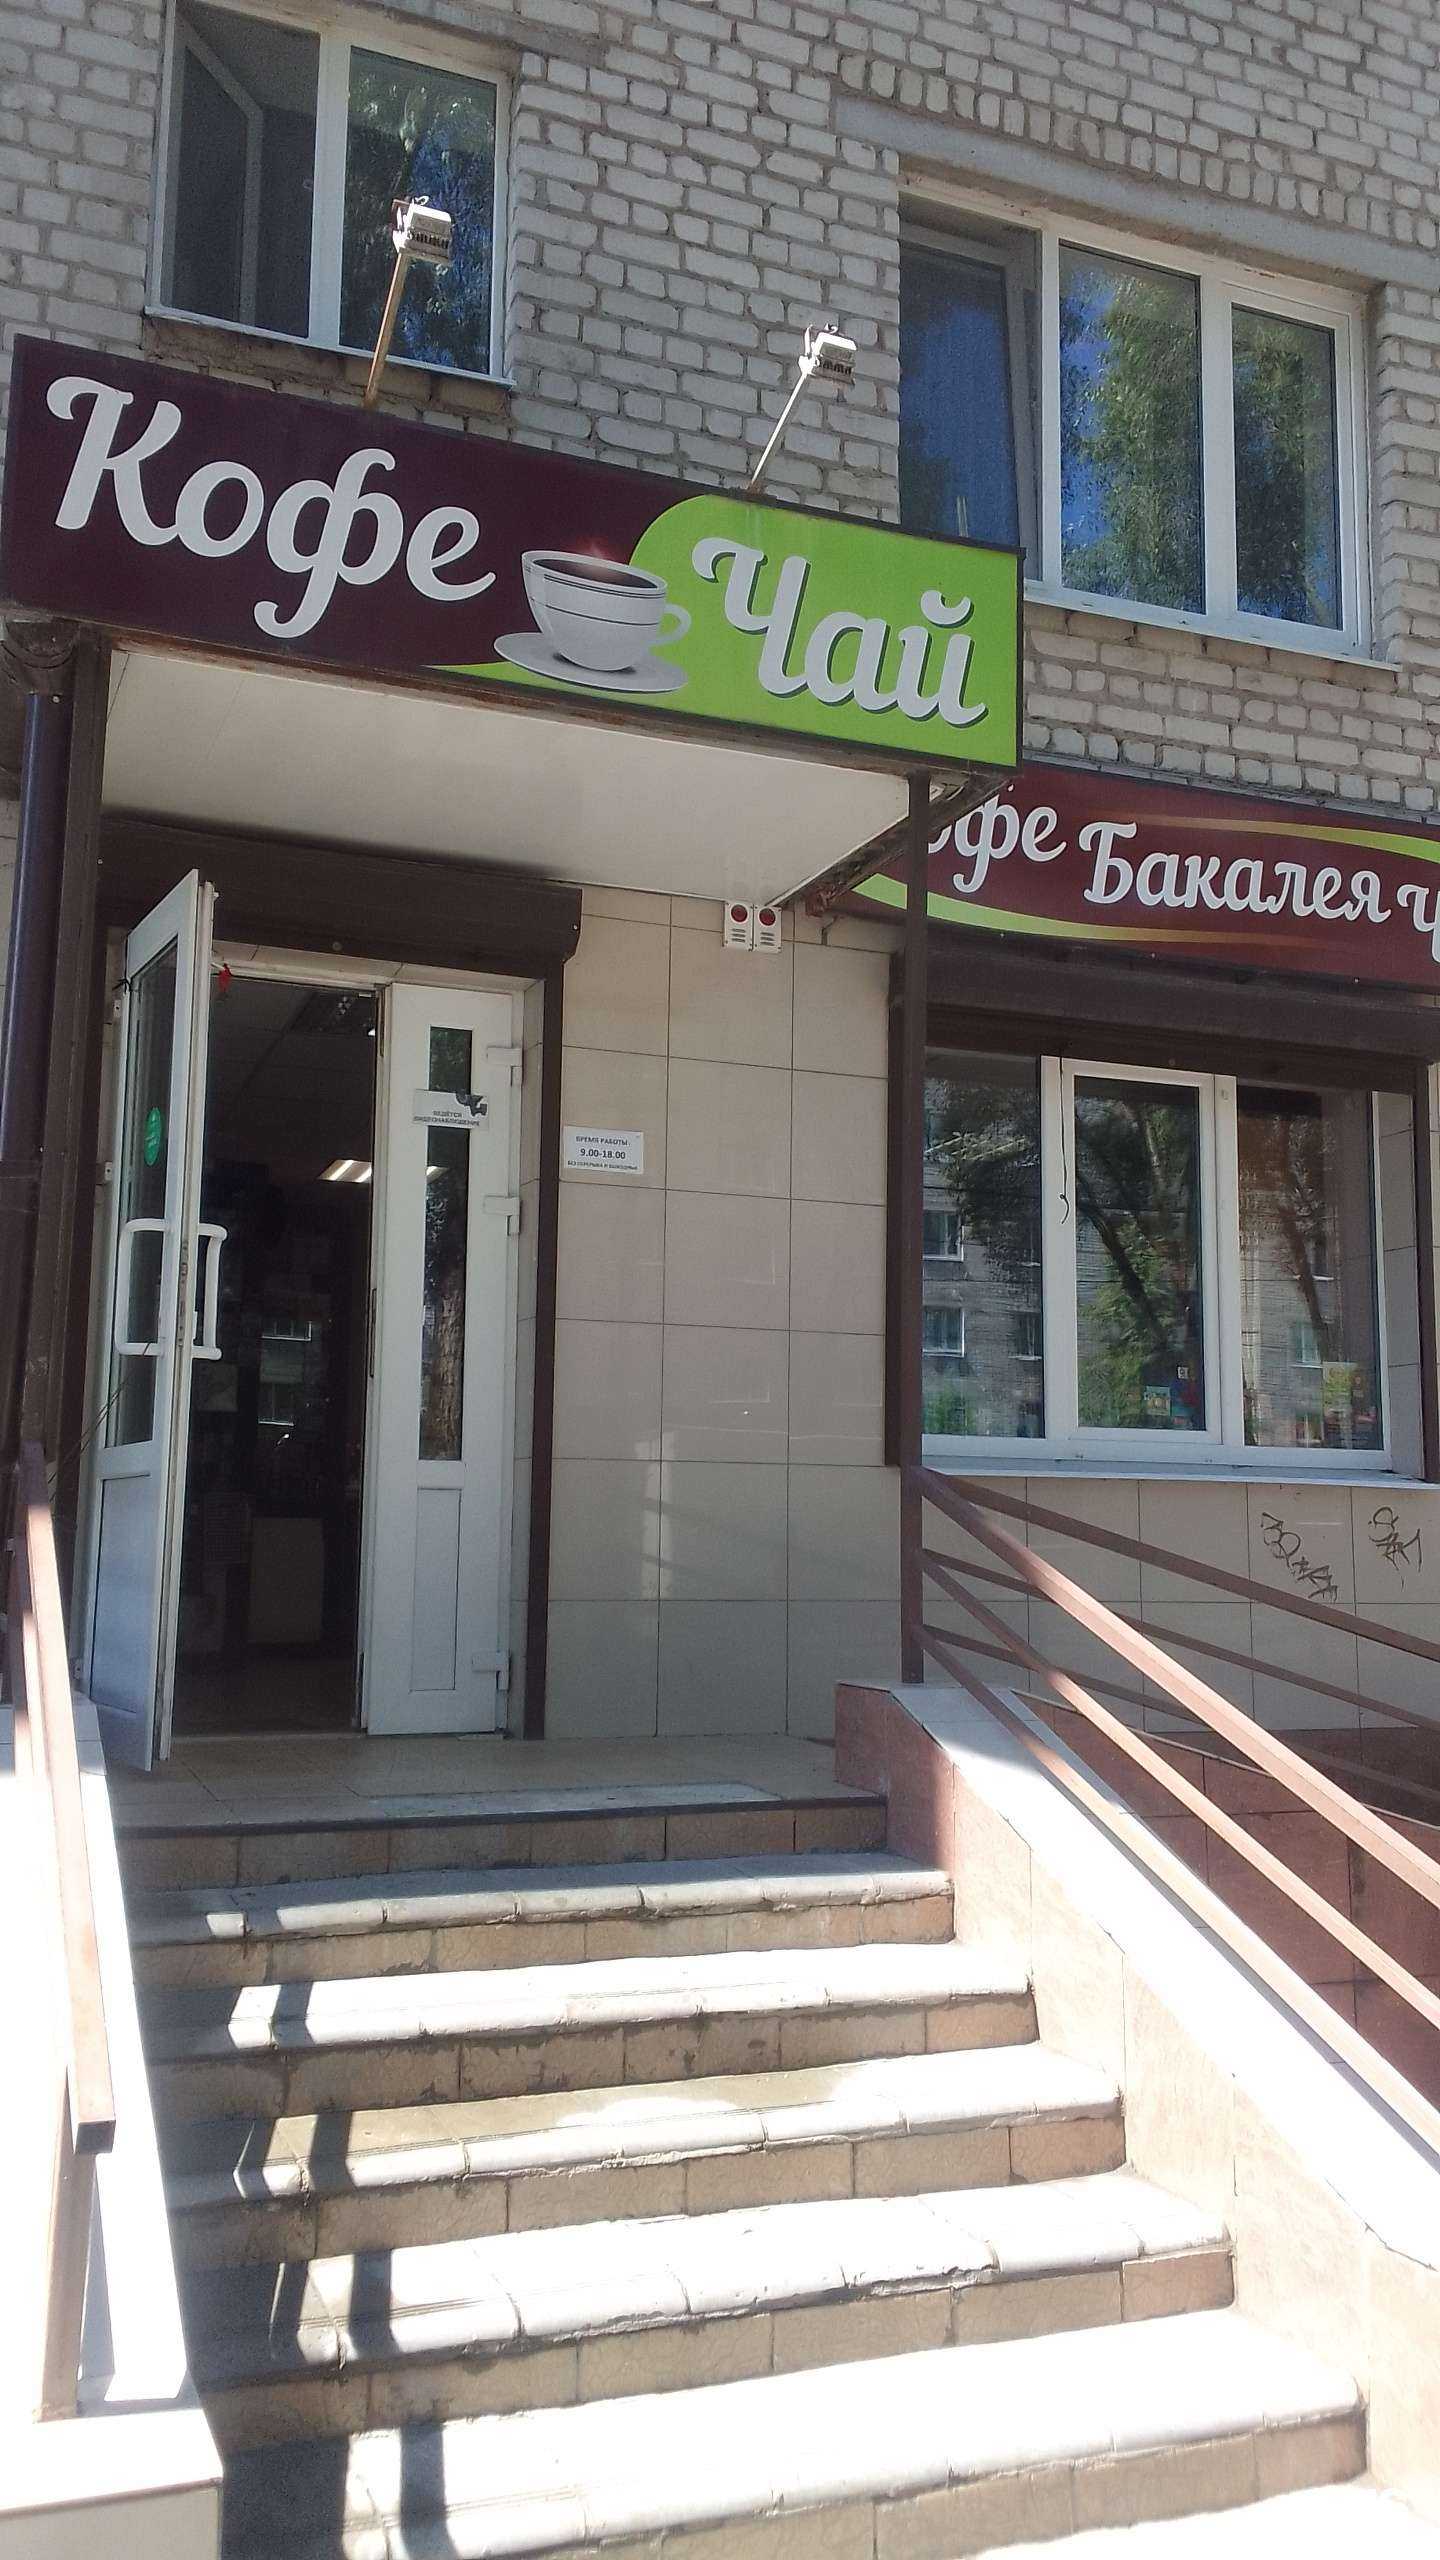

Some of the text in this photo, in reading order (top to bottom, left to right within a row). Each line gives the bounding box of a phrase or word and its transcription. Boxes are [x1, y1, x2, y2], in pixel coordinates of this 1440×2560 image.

[46, 376, 989, 728] Кофе Чай
[928, 794, 1067, 893] фе
[1078, 821, 1392, 923] Бакалея
[580, 1148, 626, 1159] 9.00-18.00
